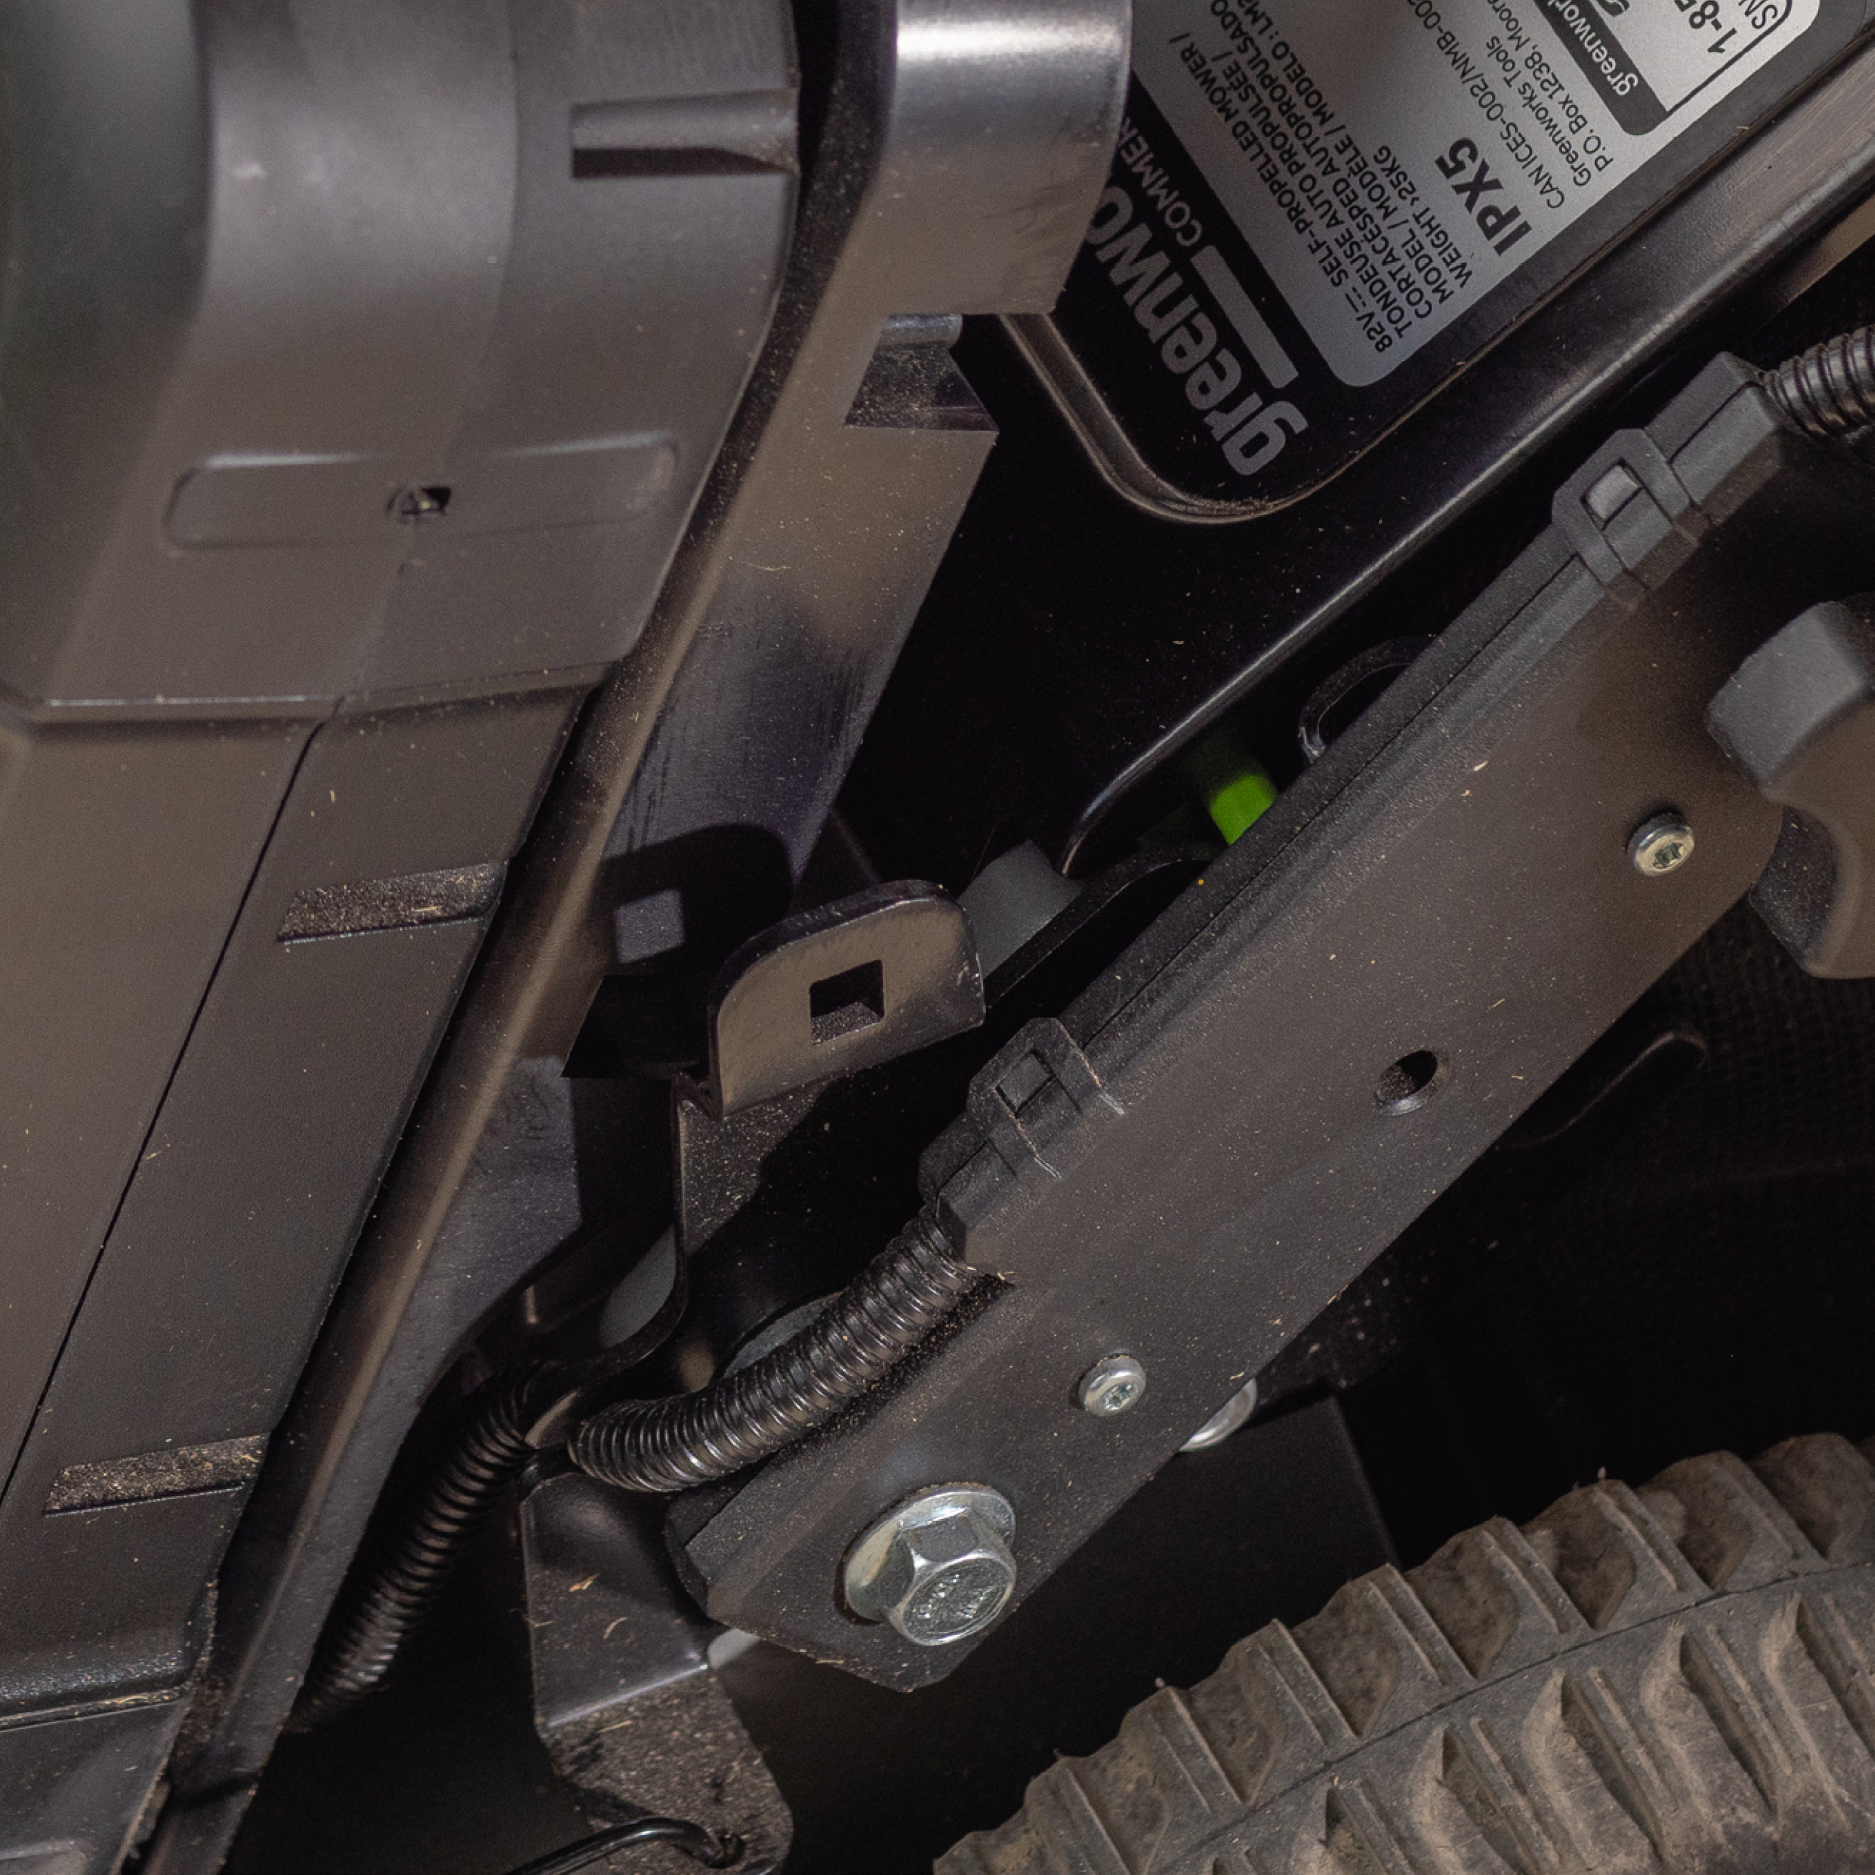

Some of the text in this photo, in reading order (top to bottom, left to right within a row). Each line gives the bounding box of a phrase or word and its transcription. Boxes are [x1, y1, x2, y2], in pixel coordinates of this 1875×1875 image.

[1178, 41, 1239, 122] MOWER
[1269, 41, 1334, 126] MODELO
[1485, 35, 1589, 185] Greenworks Tools
[1522, 45, 1564, 98] 1238,
[1558, 93, 1587, 134] Box
[1221, 59, 1305, 176] PROPULSÉE
[1581, 128, 1613, 171] P.O.
[1229, 117, 1349, 287] SELF-PROPELLED
[1297, 174, 1343, 226] AUTO
[1333, 134, 1396, 220] MODÈLE
[1434, 136, 1531, 255] IPX5
[1526, 164, 1564, 208] CAN
[1330, 177, 1431, 317] CORTACÉSPED
[1333, 227, 1412, 338] TONDEUSE
[1400, 228, 1453, 304] MODEL
[1411, 206, 1471, 288] WEIGHT
[1085, 185, 1309, 476] greenwo
